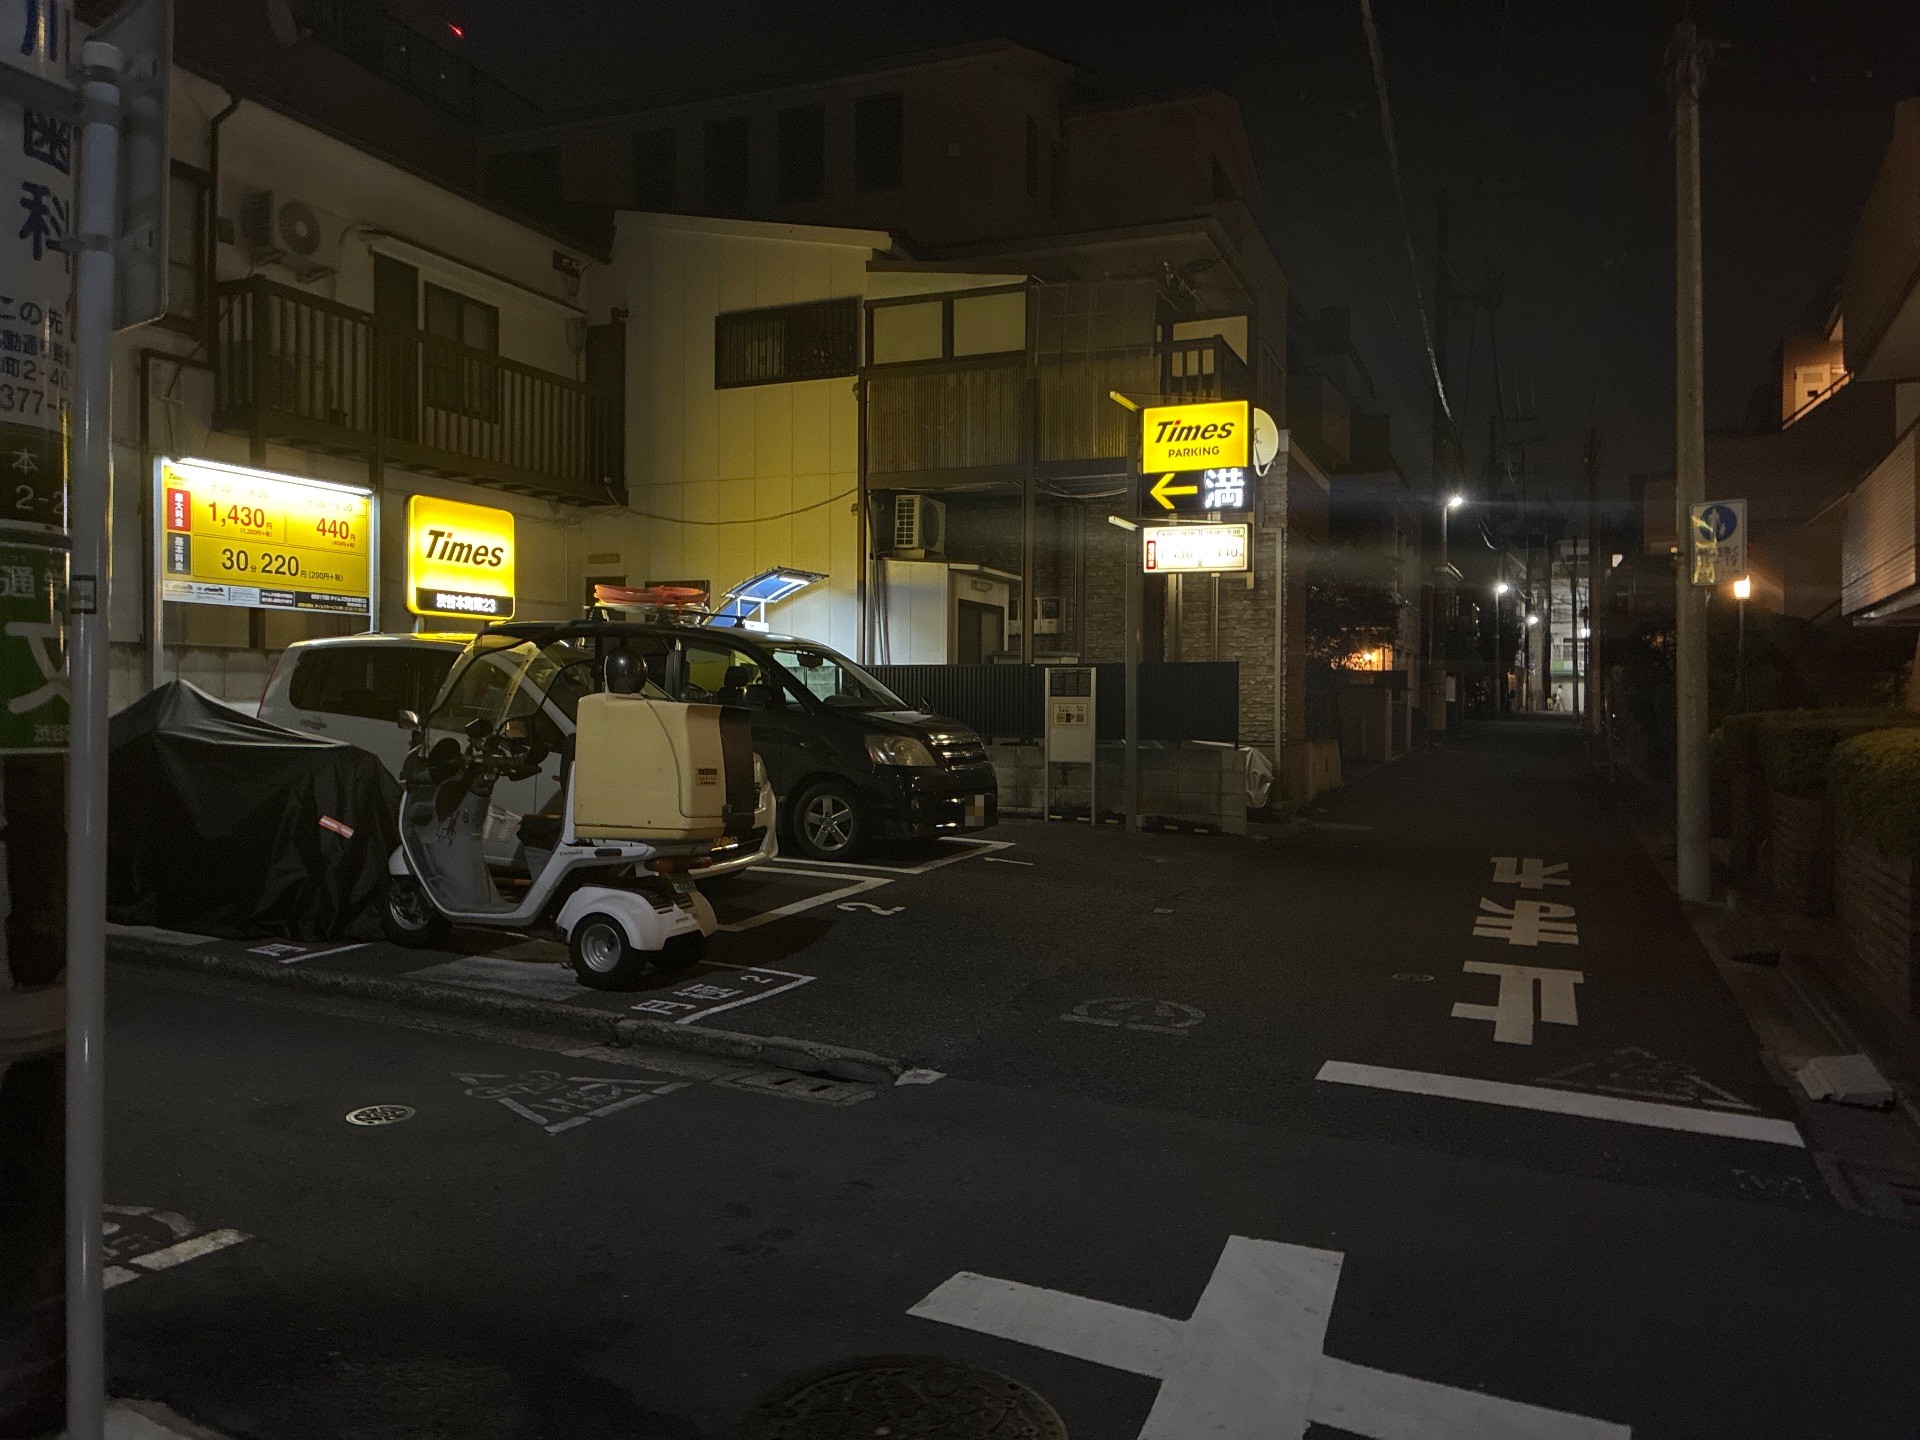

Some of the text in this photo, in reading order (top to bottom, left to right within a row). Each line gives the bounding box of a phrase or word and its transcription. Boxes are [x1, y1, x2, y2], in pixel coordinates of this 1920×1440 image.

[1155, 420, 1234, 444] Times
[1168, 445, 1220, 458] PARKING
[1204, 467, 1245, 509] 満
[426, 529, 504, 567] Times
[836, 901, 907, 916] 2
[740, 974, 774, 985] 2
